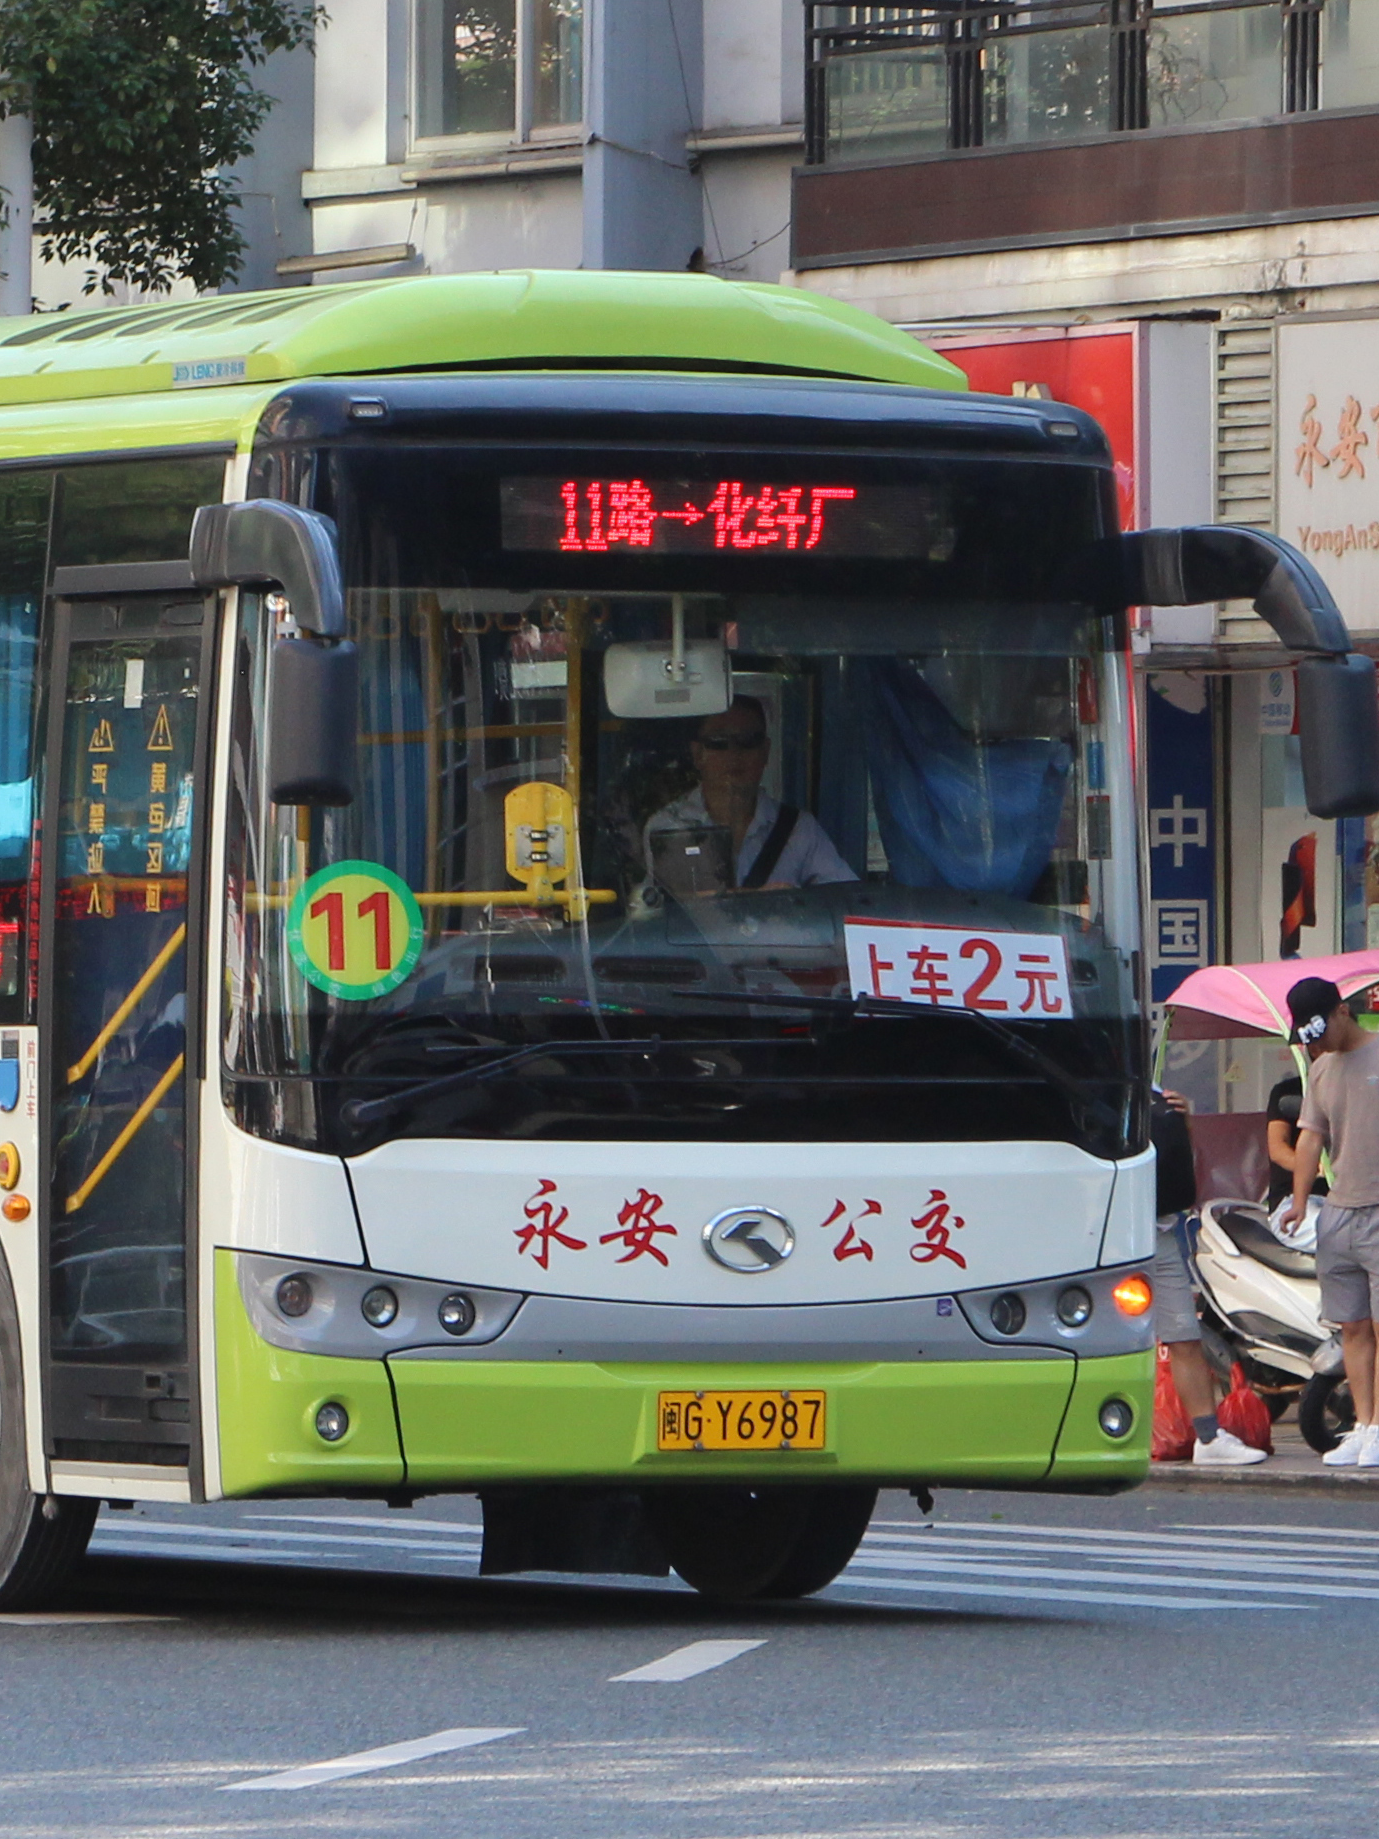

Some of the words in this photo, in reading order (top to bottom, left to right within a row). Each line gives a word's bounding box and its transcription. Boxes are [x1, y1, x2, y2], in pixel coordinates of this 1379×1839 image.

[1295, 393, 1379, 489] 永安
[310, 892, 392, 971] 11
[867, 937, 1063, 1013] 上车2元
[513, 1179, 678, 1270] 永安
[821, 1188, 967, 1270] 公交
